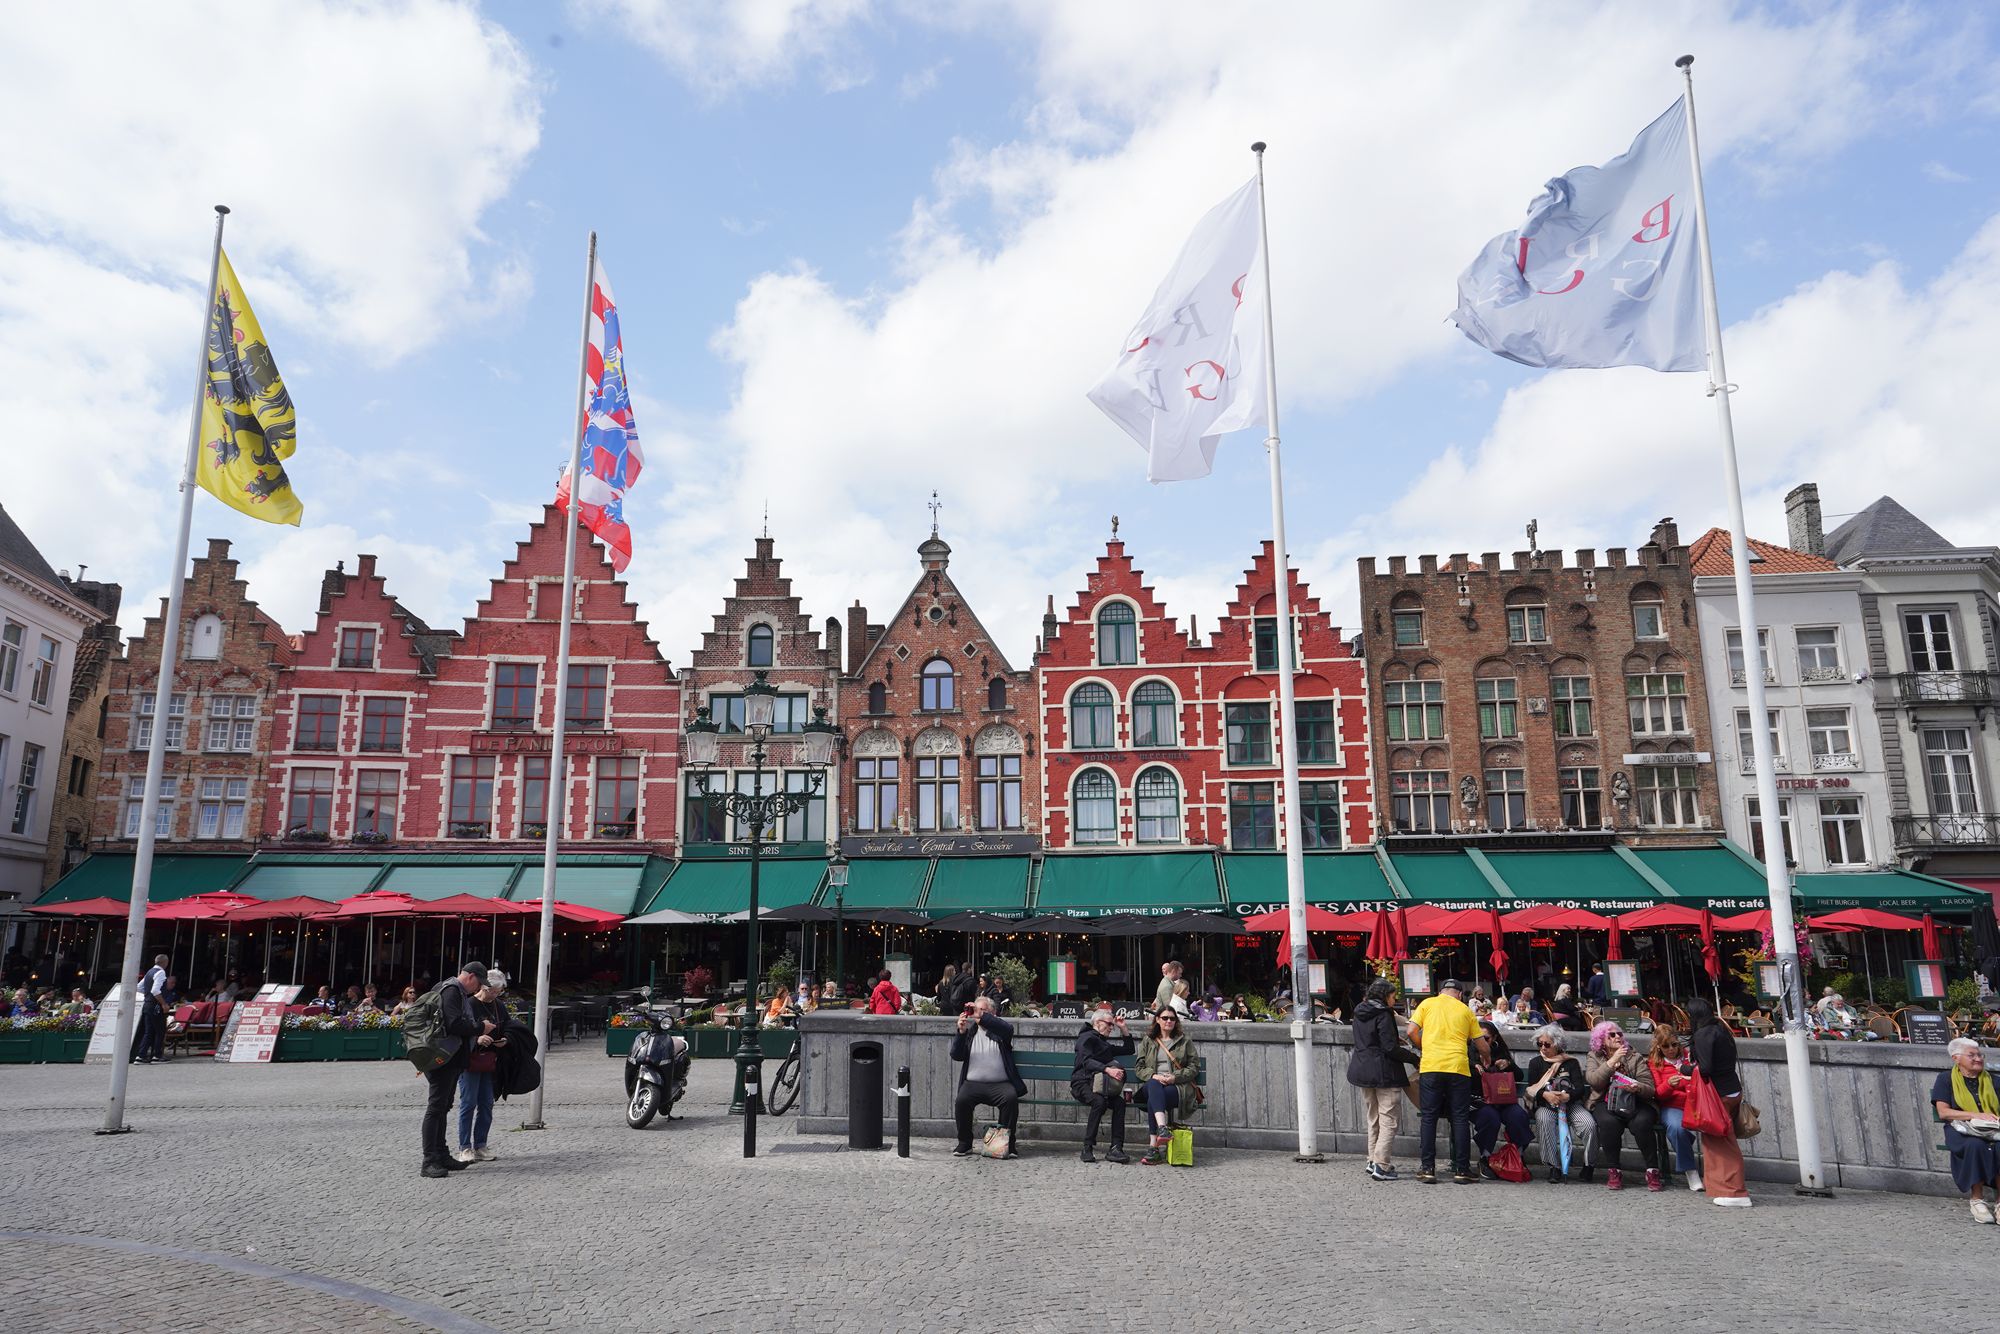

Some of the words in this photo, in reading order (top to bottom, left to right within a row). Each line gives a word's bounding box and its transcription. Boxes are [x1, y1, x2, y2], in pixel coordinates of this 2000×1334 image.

[477, 737, 499, 751] LE
[504, 737, 571, 751] PANIR
[576, 738, 617, 751] D'OR
[1821, 777, 1850, 789] 1900
[728, 847, 750, 855] SINT
[756, 846, 780, 855] ORIS
[920, 838, 954, 853] Central
[1343, 901, 1399, 913] ARTS
[1497, 900, 1512, 908] La
[1513, 900, 1554, 909] Civi
[1557, 900, 1581, 909] d'Or
[1590, 899, 1654, 909] Restaurant
[1708, 899, 1736, 908] Petit
[1739, 898, 1765, 908] café
[1067, 909, 1089, 917] Pizza
[1100, 908, 1112, 916] LA
[1152, 907, 1174, 915] D'OR
[1116, 1007, 1140, 1019] Beer
